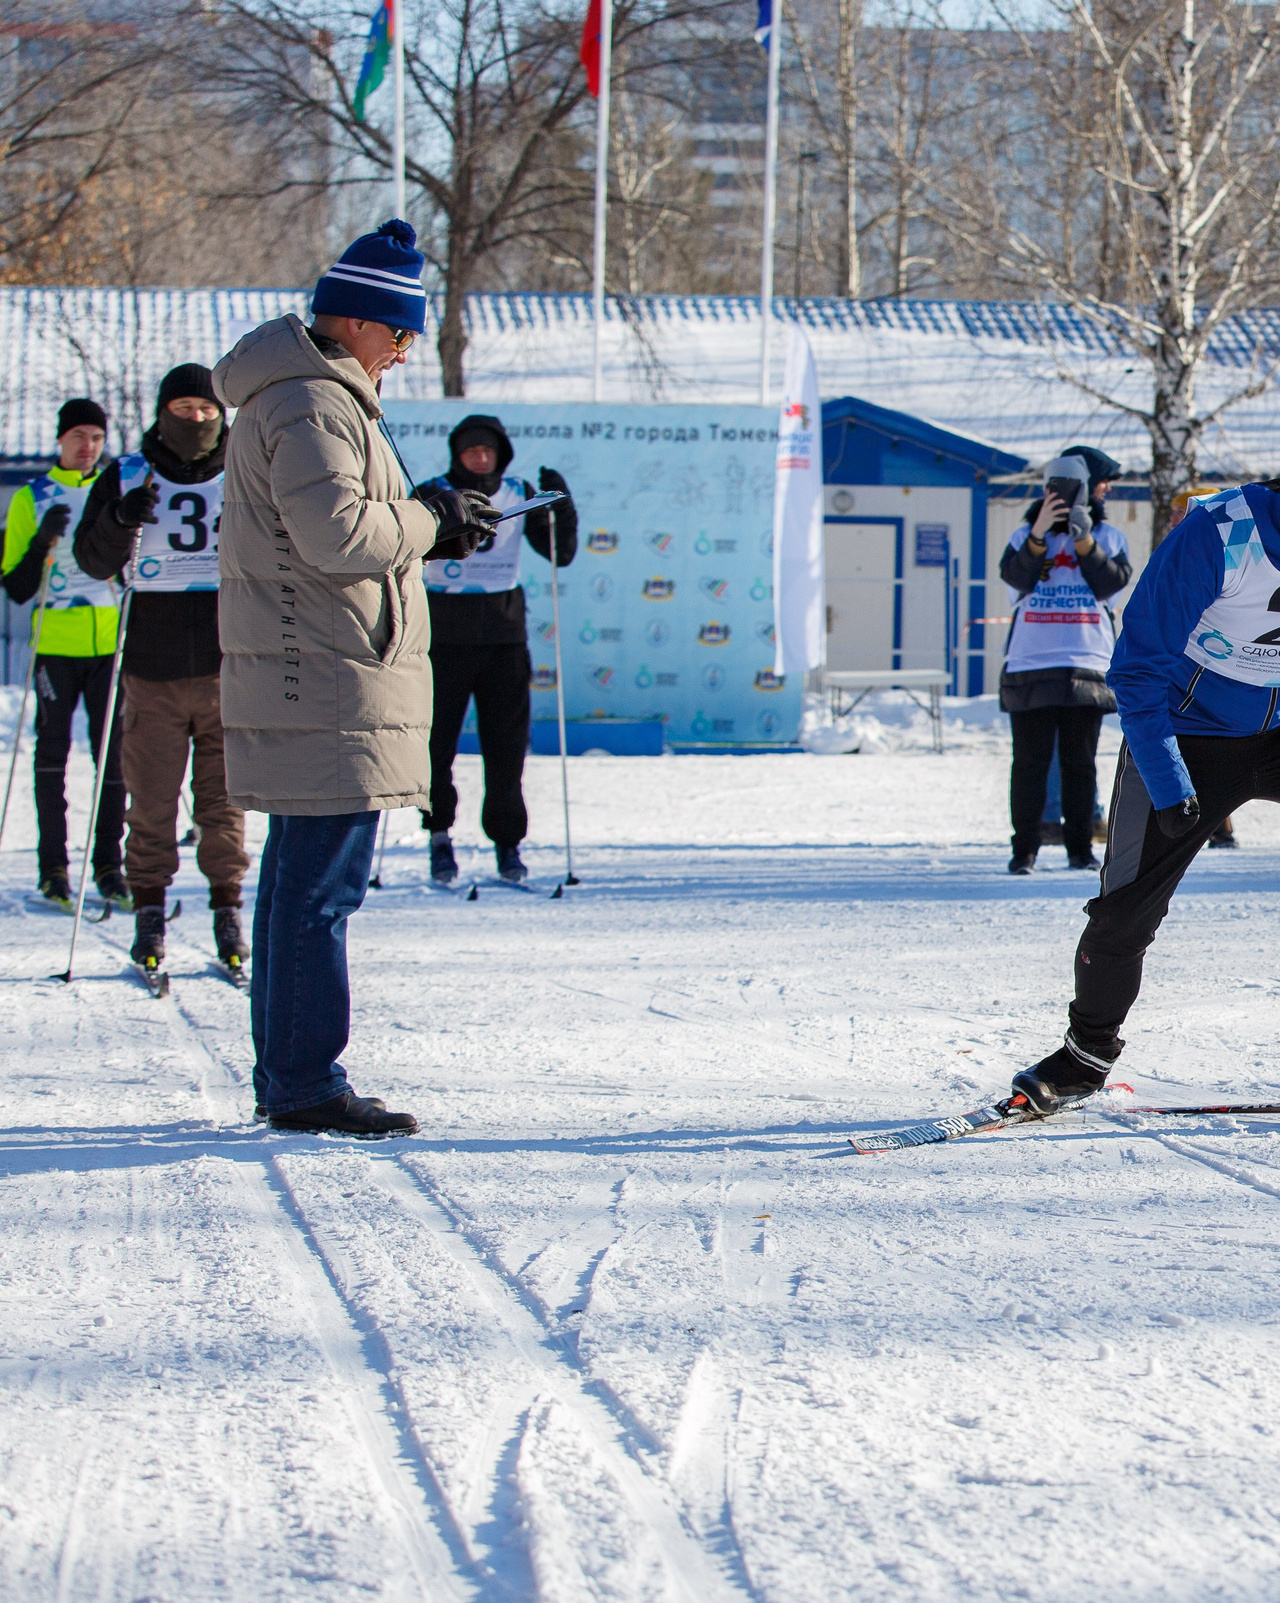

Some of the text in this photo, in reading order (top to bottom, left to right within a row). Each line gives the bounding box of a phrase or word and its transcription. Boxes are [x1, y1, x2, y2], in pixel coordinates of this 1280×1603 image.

[581, 420, 617, 441] №2
[624, 426, 700, 445] города
[708, 422, 780, 443] Тюмен
[168, 491, 222, 552] 3
[1028, 596, 1097, 608] ОТЕЧЕСТВА
[281, 584, 300, 702] ATHLETES
[905, 1115, 974, 1147] ROSSIGNOL
